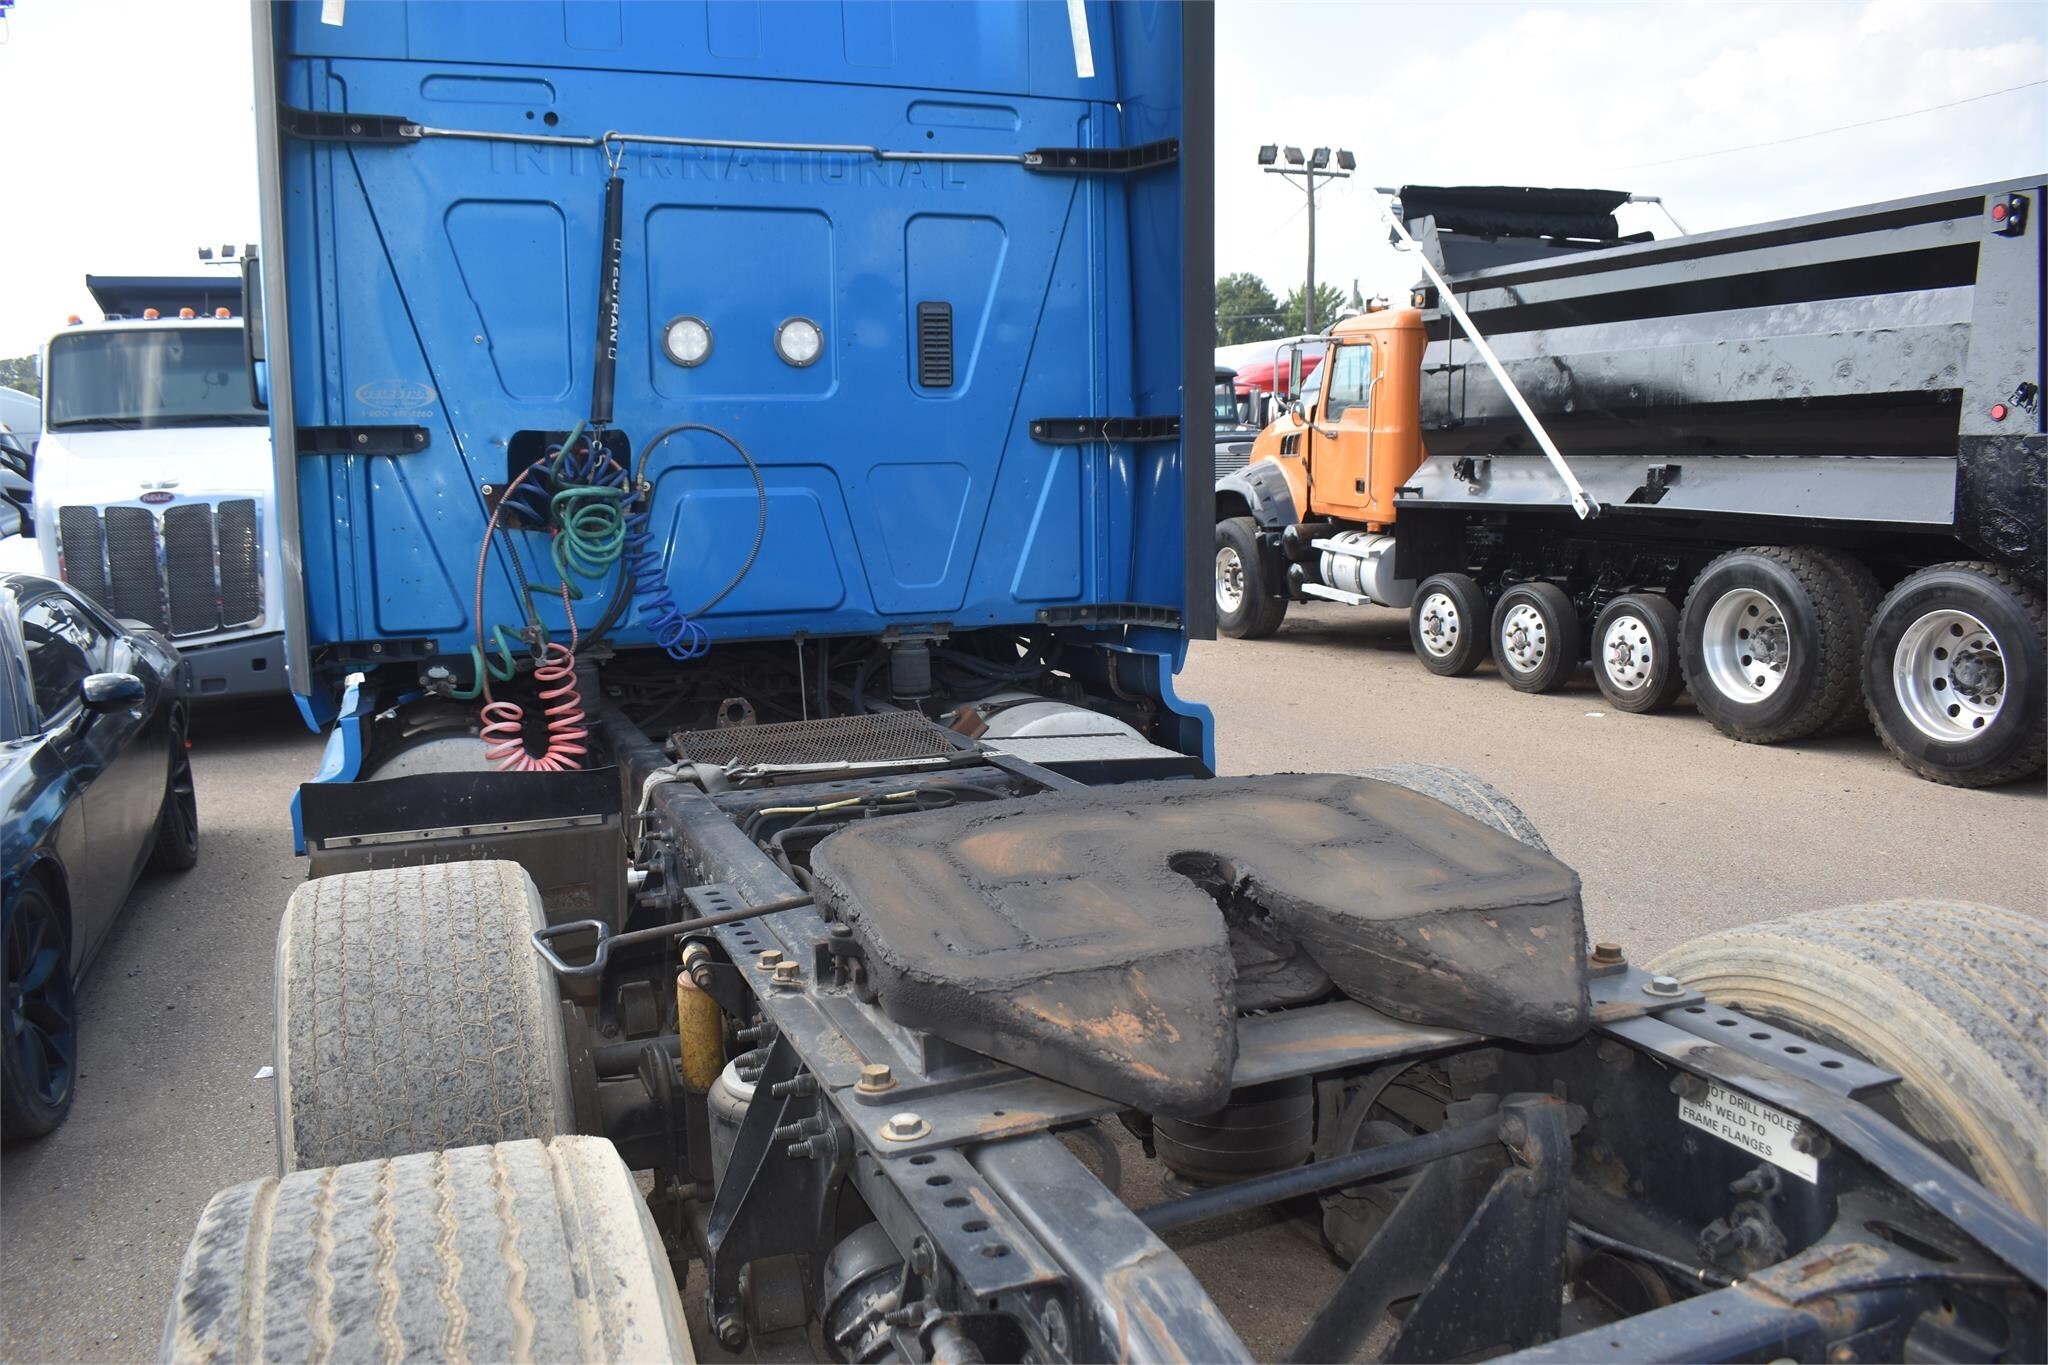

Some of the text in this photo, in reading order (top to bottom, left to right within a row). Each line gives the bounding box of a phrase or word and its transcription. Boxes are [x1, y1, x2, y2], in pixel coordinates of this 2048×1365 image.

[1682, 1106, 1773, 1156] FRAME FLANGES
[1709, 1085, 1801, 1133] OT DRILL HOLES
[1715, 1105, 1746, 1126] WELD
[1750, 1121, 1766, 1136] TO
